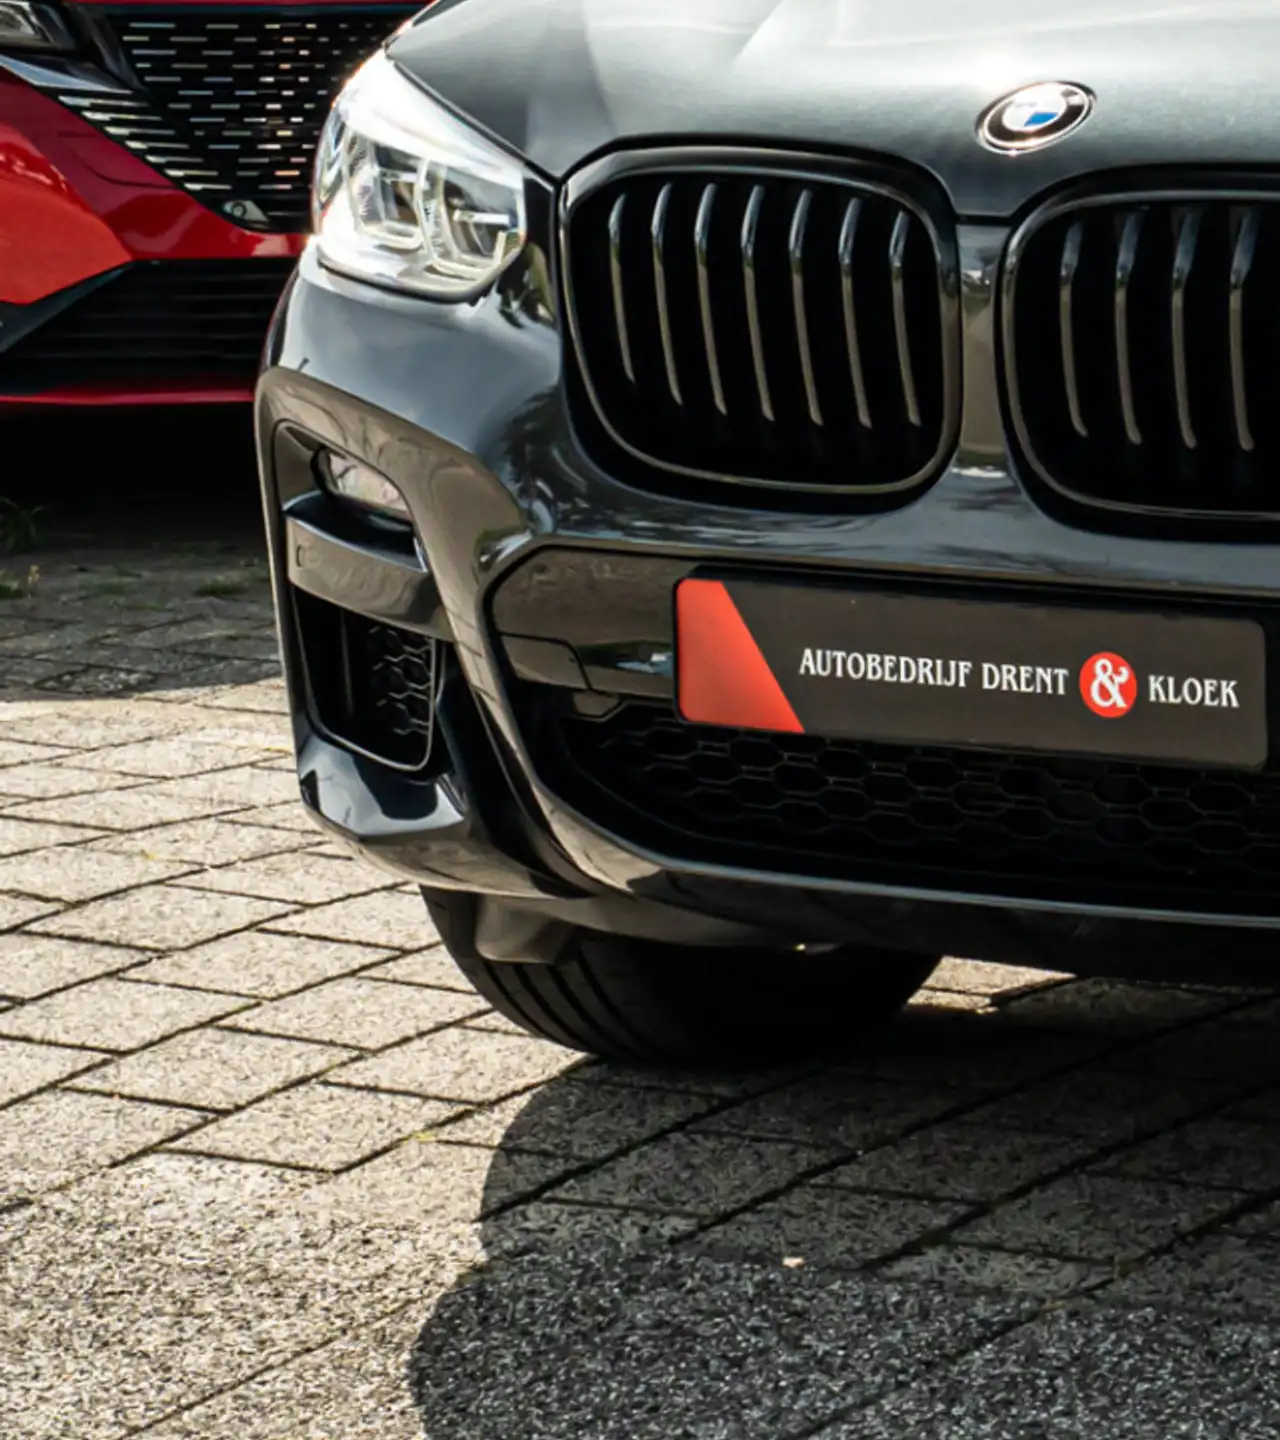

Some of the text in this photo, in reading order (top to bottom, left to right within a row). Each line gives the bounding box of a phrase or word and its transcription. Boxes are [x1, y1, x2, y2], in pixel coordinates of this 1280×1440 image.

[799, 647, 1239, 709] AUTOBEDRIJF DRENT & KLOEK
